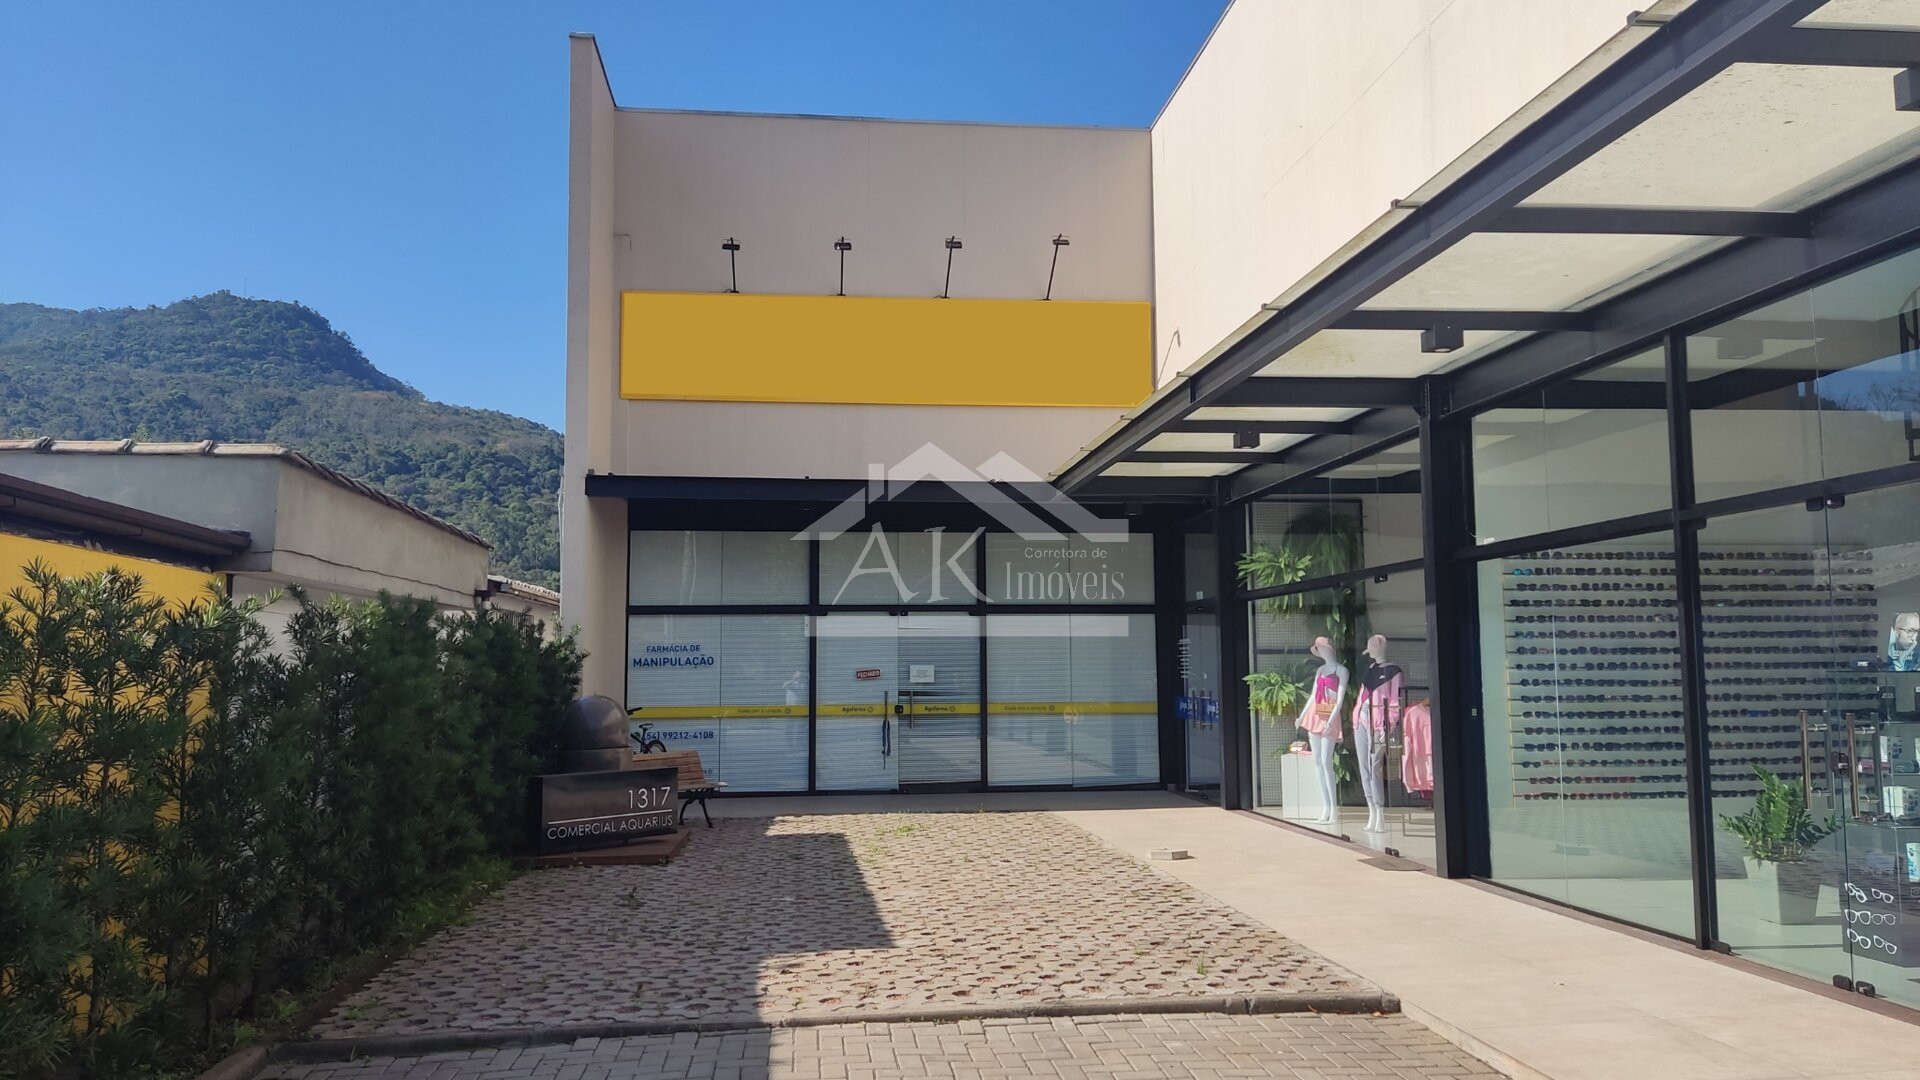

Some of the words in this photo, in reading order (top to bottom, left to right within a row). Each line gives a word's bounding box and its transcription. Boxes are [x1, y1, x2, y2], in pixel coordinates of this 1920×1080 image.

[646, 643, 688, 653] FARMÁCIA
[690, 644, 701, 652] DE
[633, 654, 714, 669] MANIPULAÇÃO
[662, 731, 714, 740] 99212-4108
[628, 786, 671, 809] 1317
[547, 821, 617, 840] COMERCIAL
[620, 814, 673, 831] AQUARIUS
